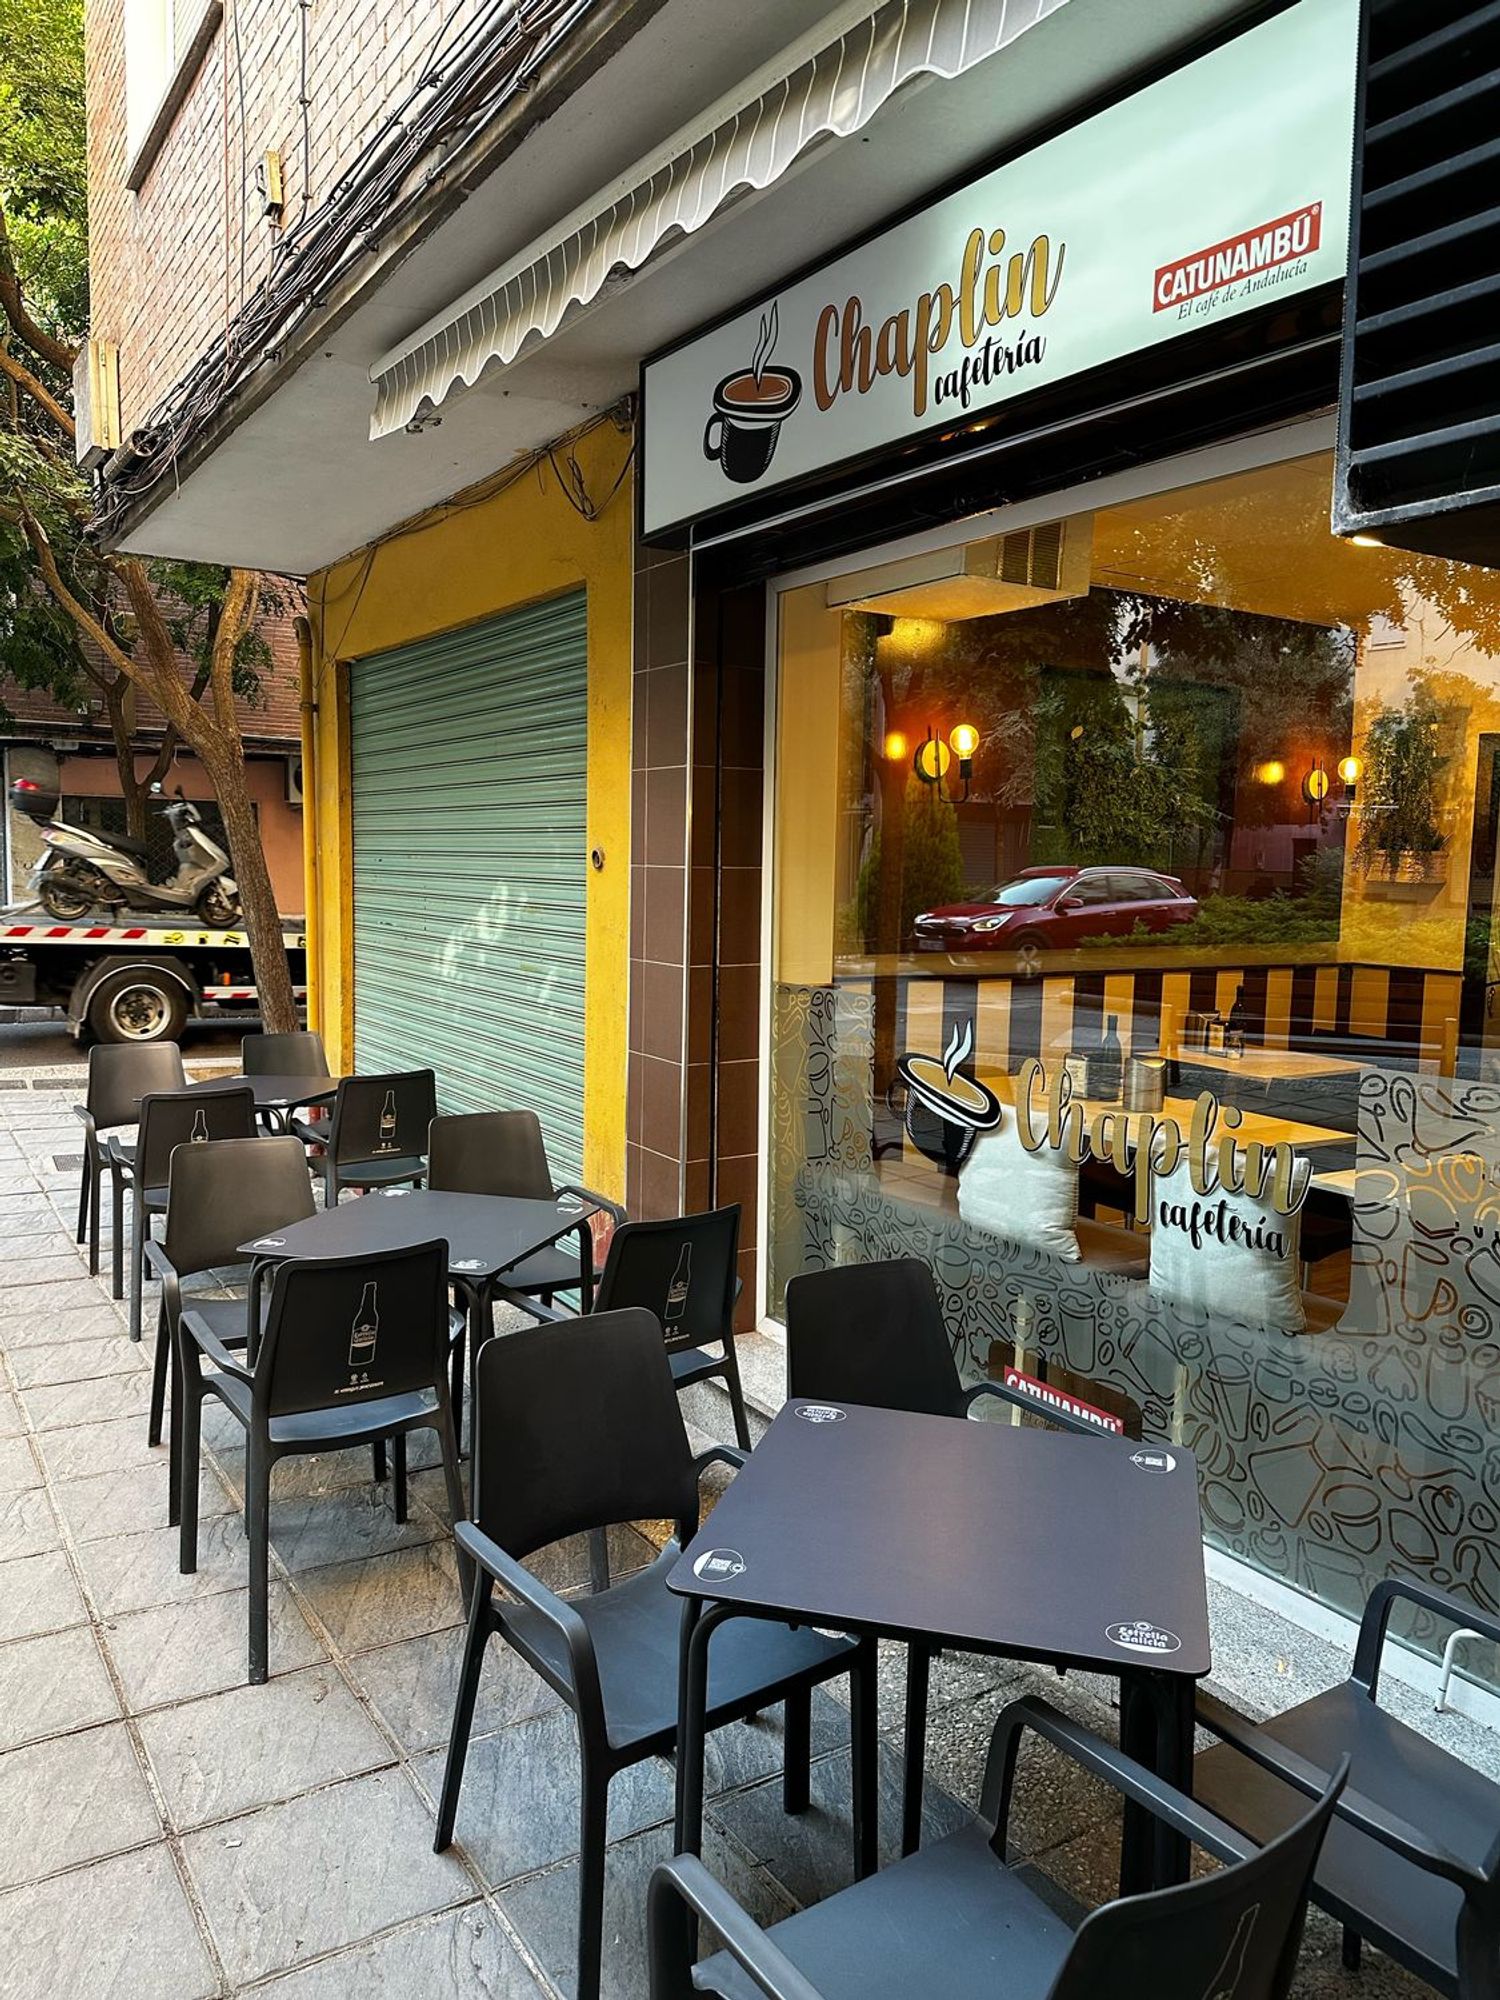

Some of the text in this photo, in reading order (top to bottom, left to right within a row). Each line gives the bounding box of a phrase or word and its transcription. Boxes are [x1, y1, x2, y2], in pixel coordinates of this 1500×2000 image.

[1157, 213, 1311, 305] CATUNAMBÚ
[1177, 259, 1308, 320] El café de Andalucía
[813, 227, 1066, 417] Chaplin
[934, 329, 1047, 409] cafetería
[1016, 1057, 1315, 1226] Chaplin
[1159, 1199, 1292, 1259] cafetería
